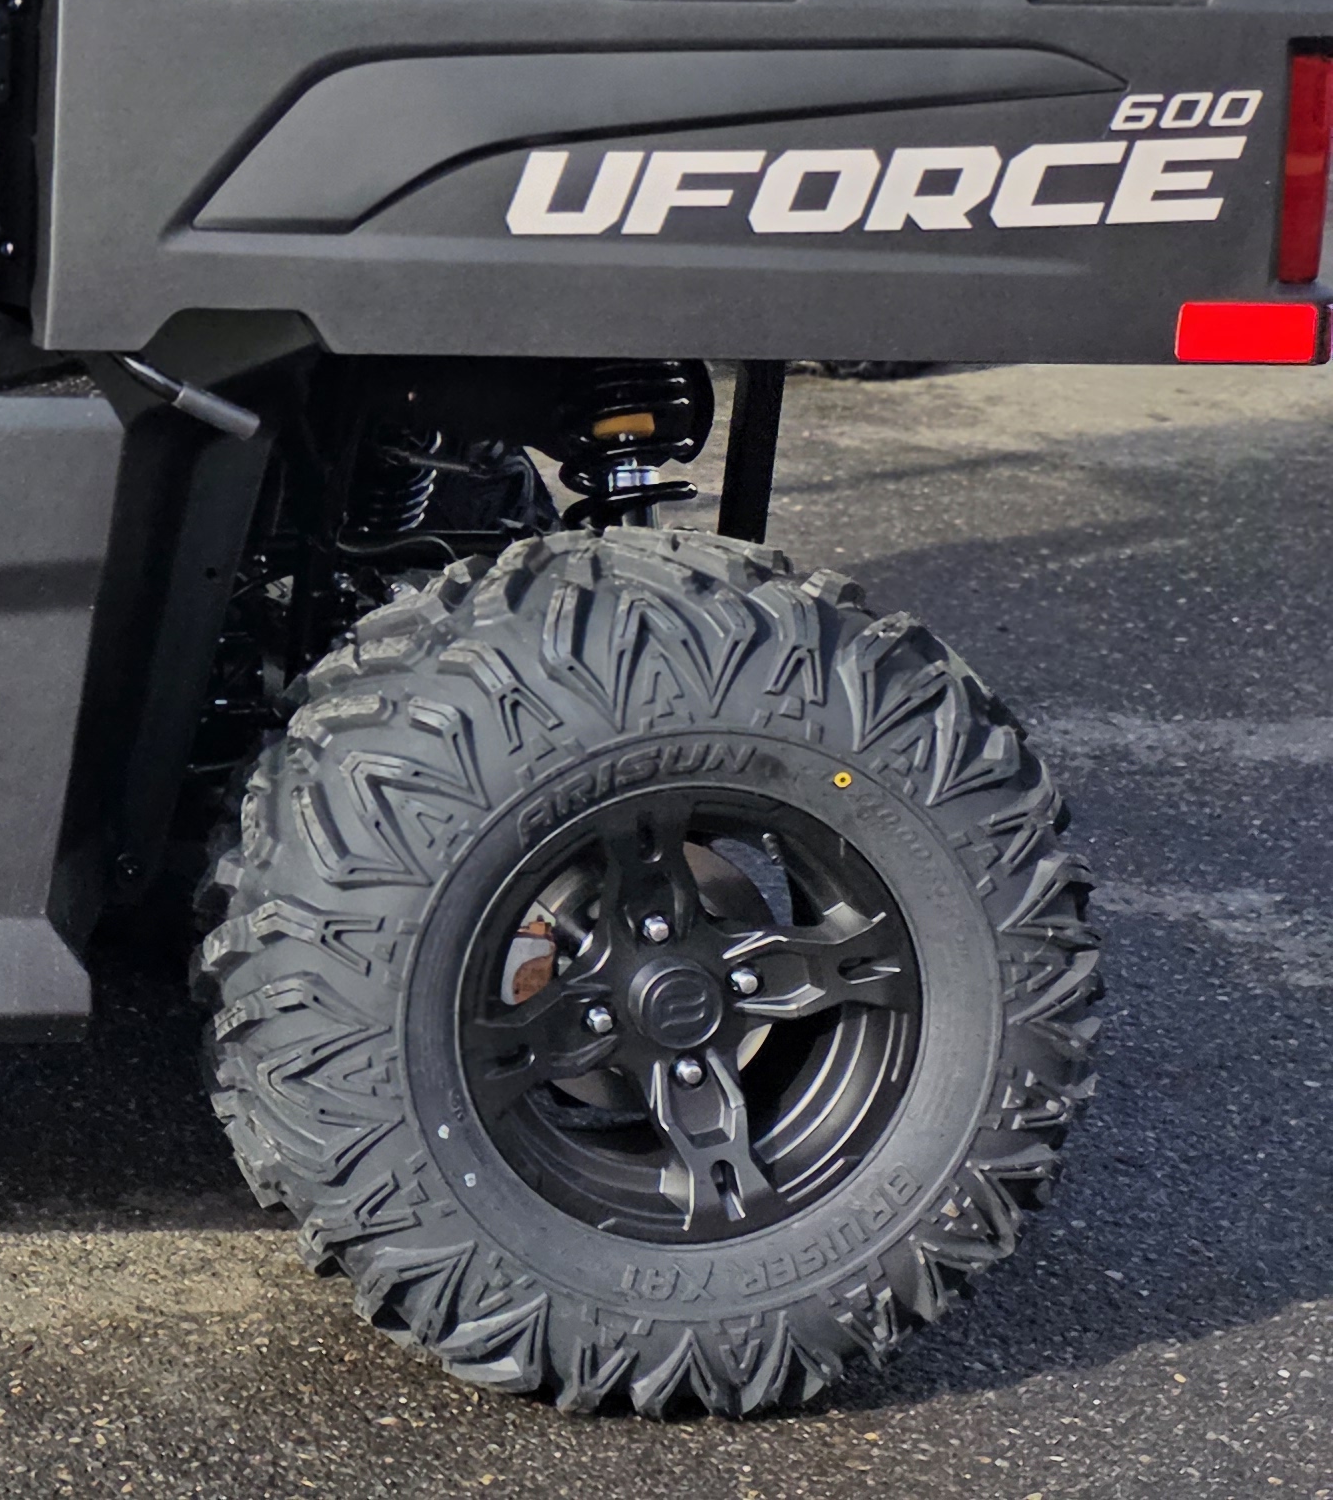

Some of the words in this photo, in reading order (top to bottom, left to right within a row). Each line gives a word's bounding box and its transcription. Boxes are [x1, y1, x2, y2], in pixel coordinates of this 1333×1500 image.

[1109, 89, 1264, 131] 600
[506, 136, 1247, 235] UFORCE
[517, 743, 758, 848] ARISUN
[737, 1164, 924, 1298] BRUISER
